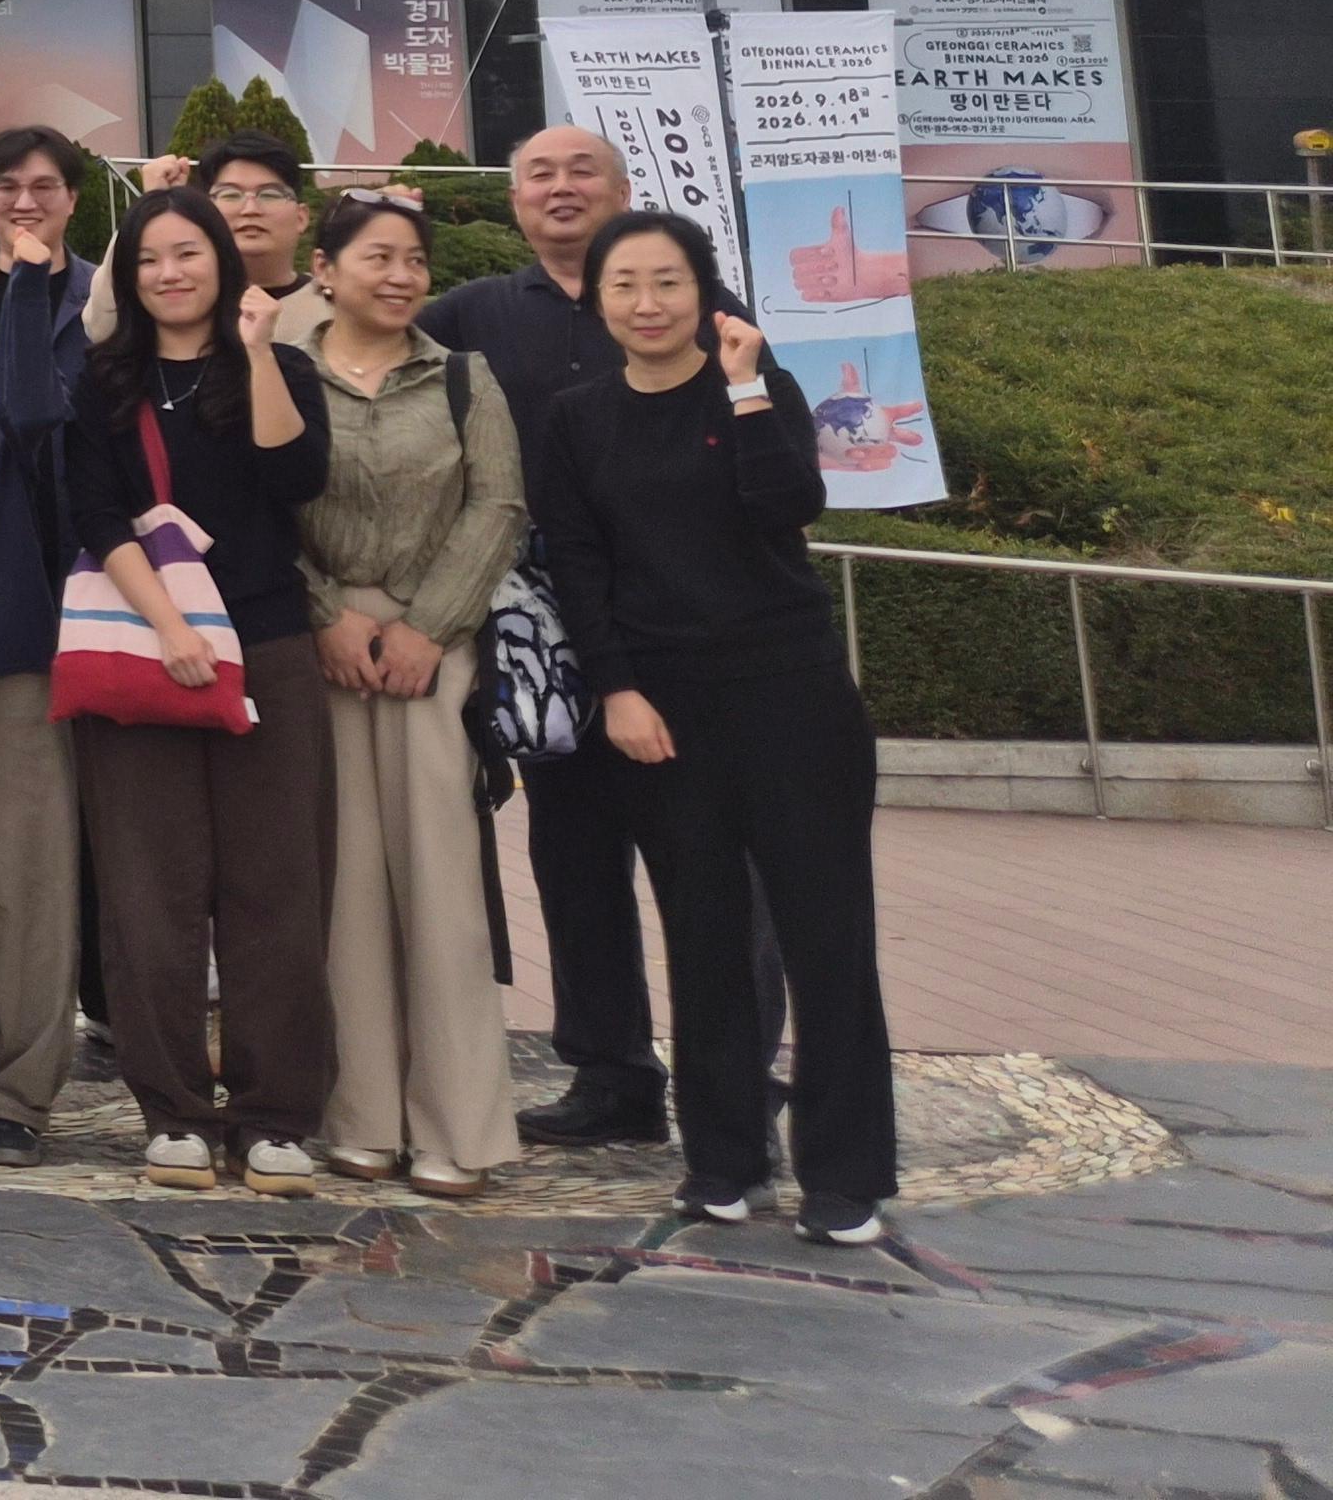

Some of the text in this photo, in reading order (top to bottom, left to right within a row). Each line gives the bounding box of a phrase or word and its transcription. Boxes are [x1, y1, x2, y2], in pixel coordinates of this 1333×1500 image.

[404, 0, 449, 23] 경기
[404, 26, 453, 48] 도자
[741, 44, 888, 58] GYEONGGI CERAMICS
[925, 41, 1065, 51] GYEONGGI CERAMICS
[383, 52, 454, 76] 박물관
[570, 50, 701, 64] EARTH MAKES
[761, 56, 873, 70] BIENNALE 2026
[945, 52, 1049, 64] BIENNALE 2026
[894, 69, 1103, 87] EARTH MAKES
[656, 107, 709, 207] 2026
